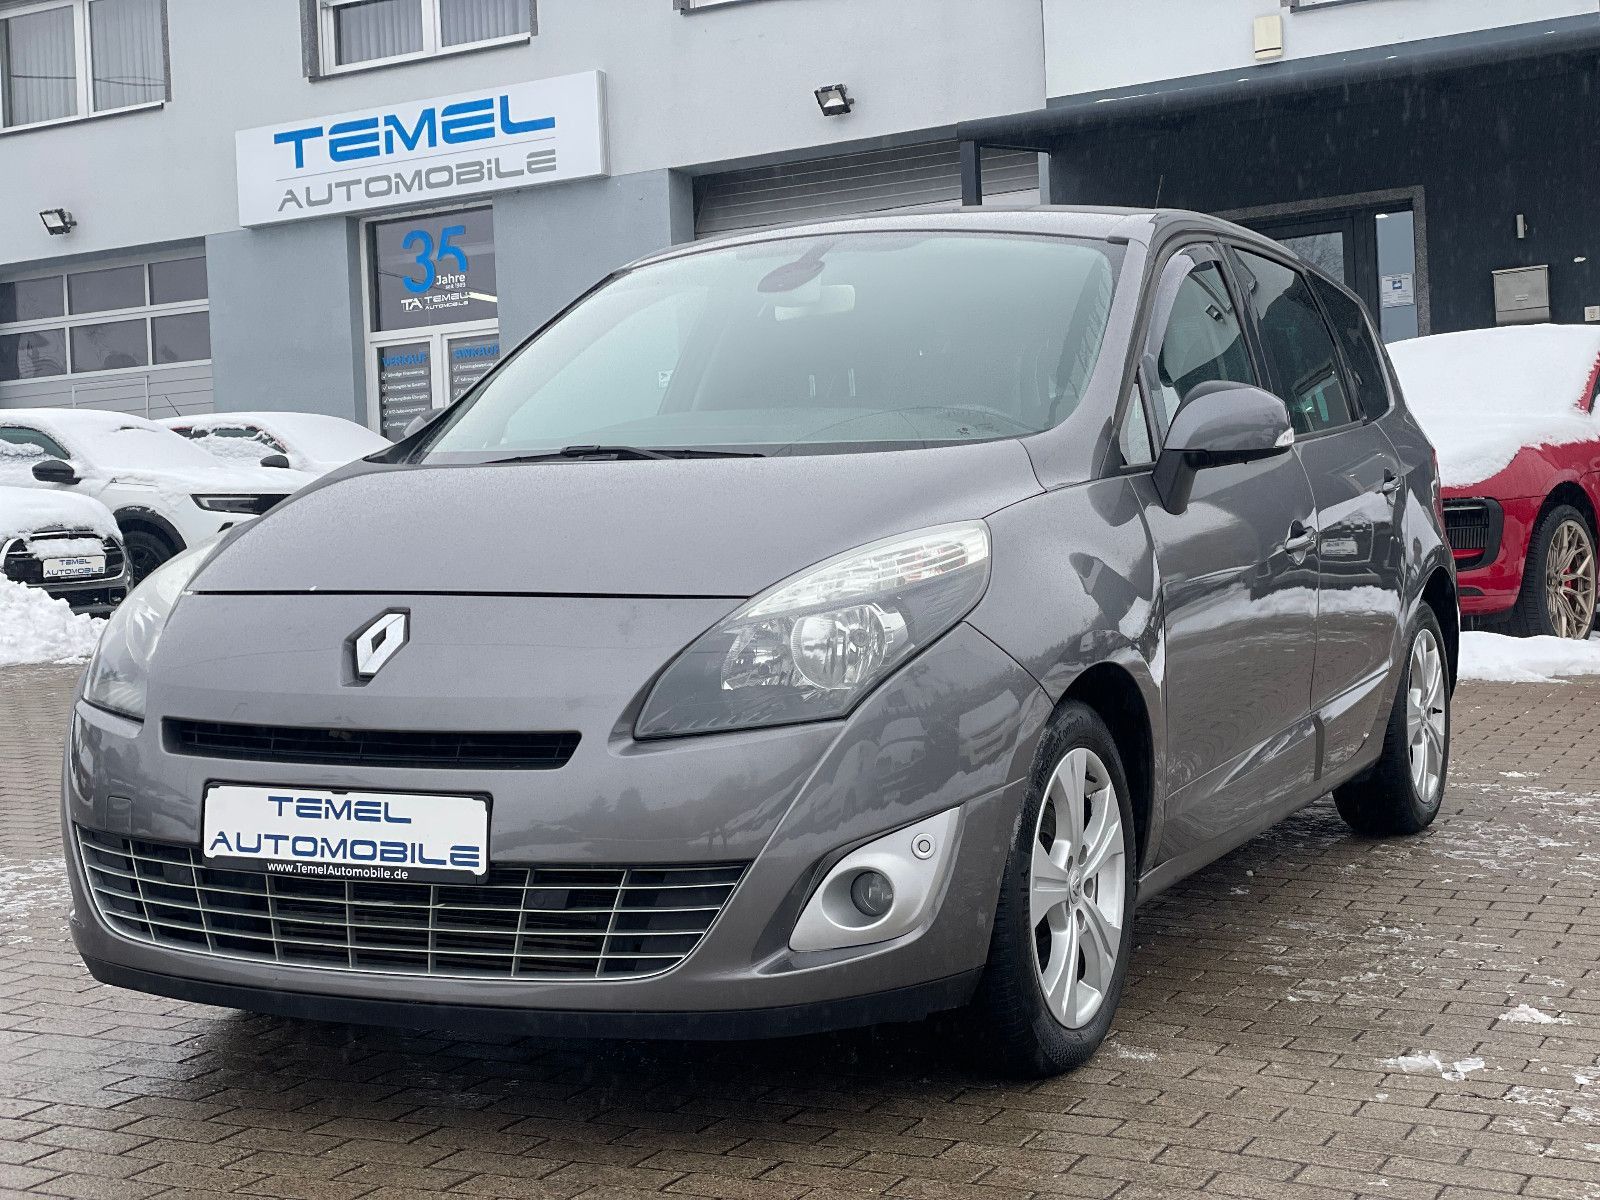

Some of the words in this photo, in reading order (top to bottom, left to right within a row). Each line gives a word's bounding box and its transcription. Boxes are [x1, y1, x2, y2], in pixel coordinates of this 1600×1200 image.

[273, 95, 556, 169] TEMEL
[402, 224, 468, 294] 35
[436, 274, 466, 286] Jahre
[424, 291, 468, 304] TEMEL
[267, 795, 412, 825] TEMEL
[209, 830, 480, 868] AUTOMOBILE
[267, 861, 409, 880] www.TemelAutomobile.de
